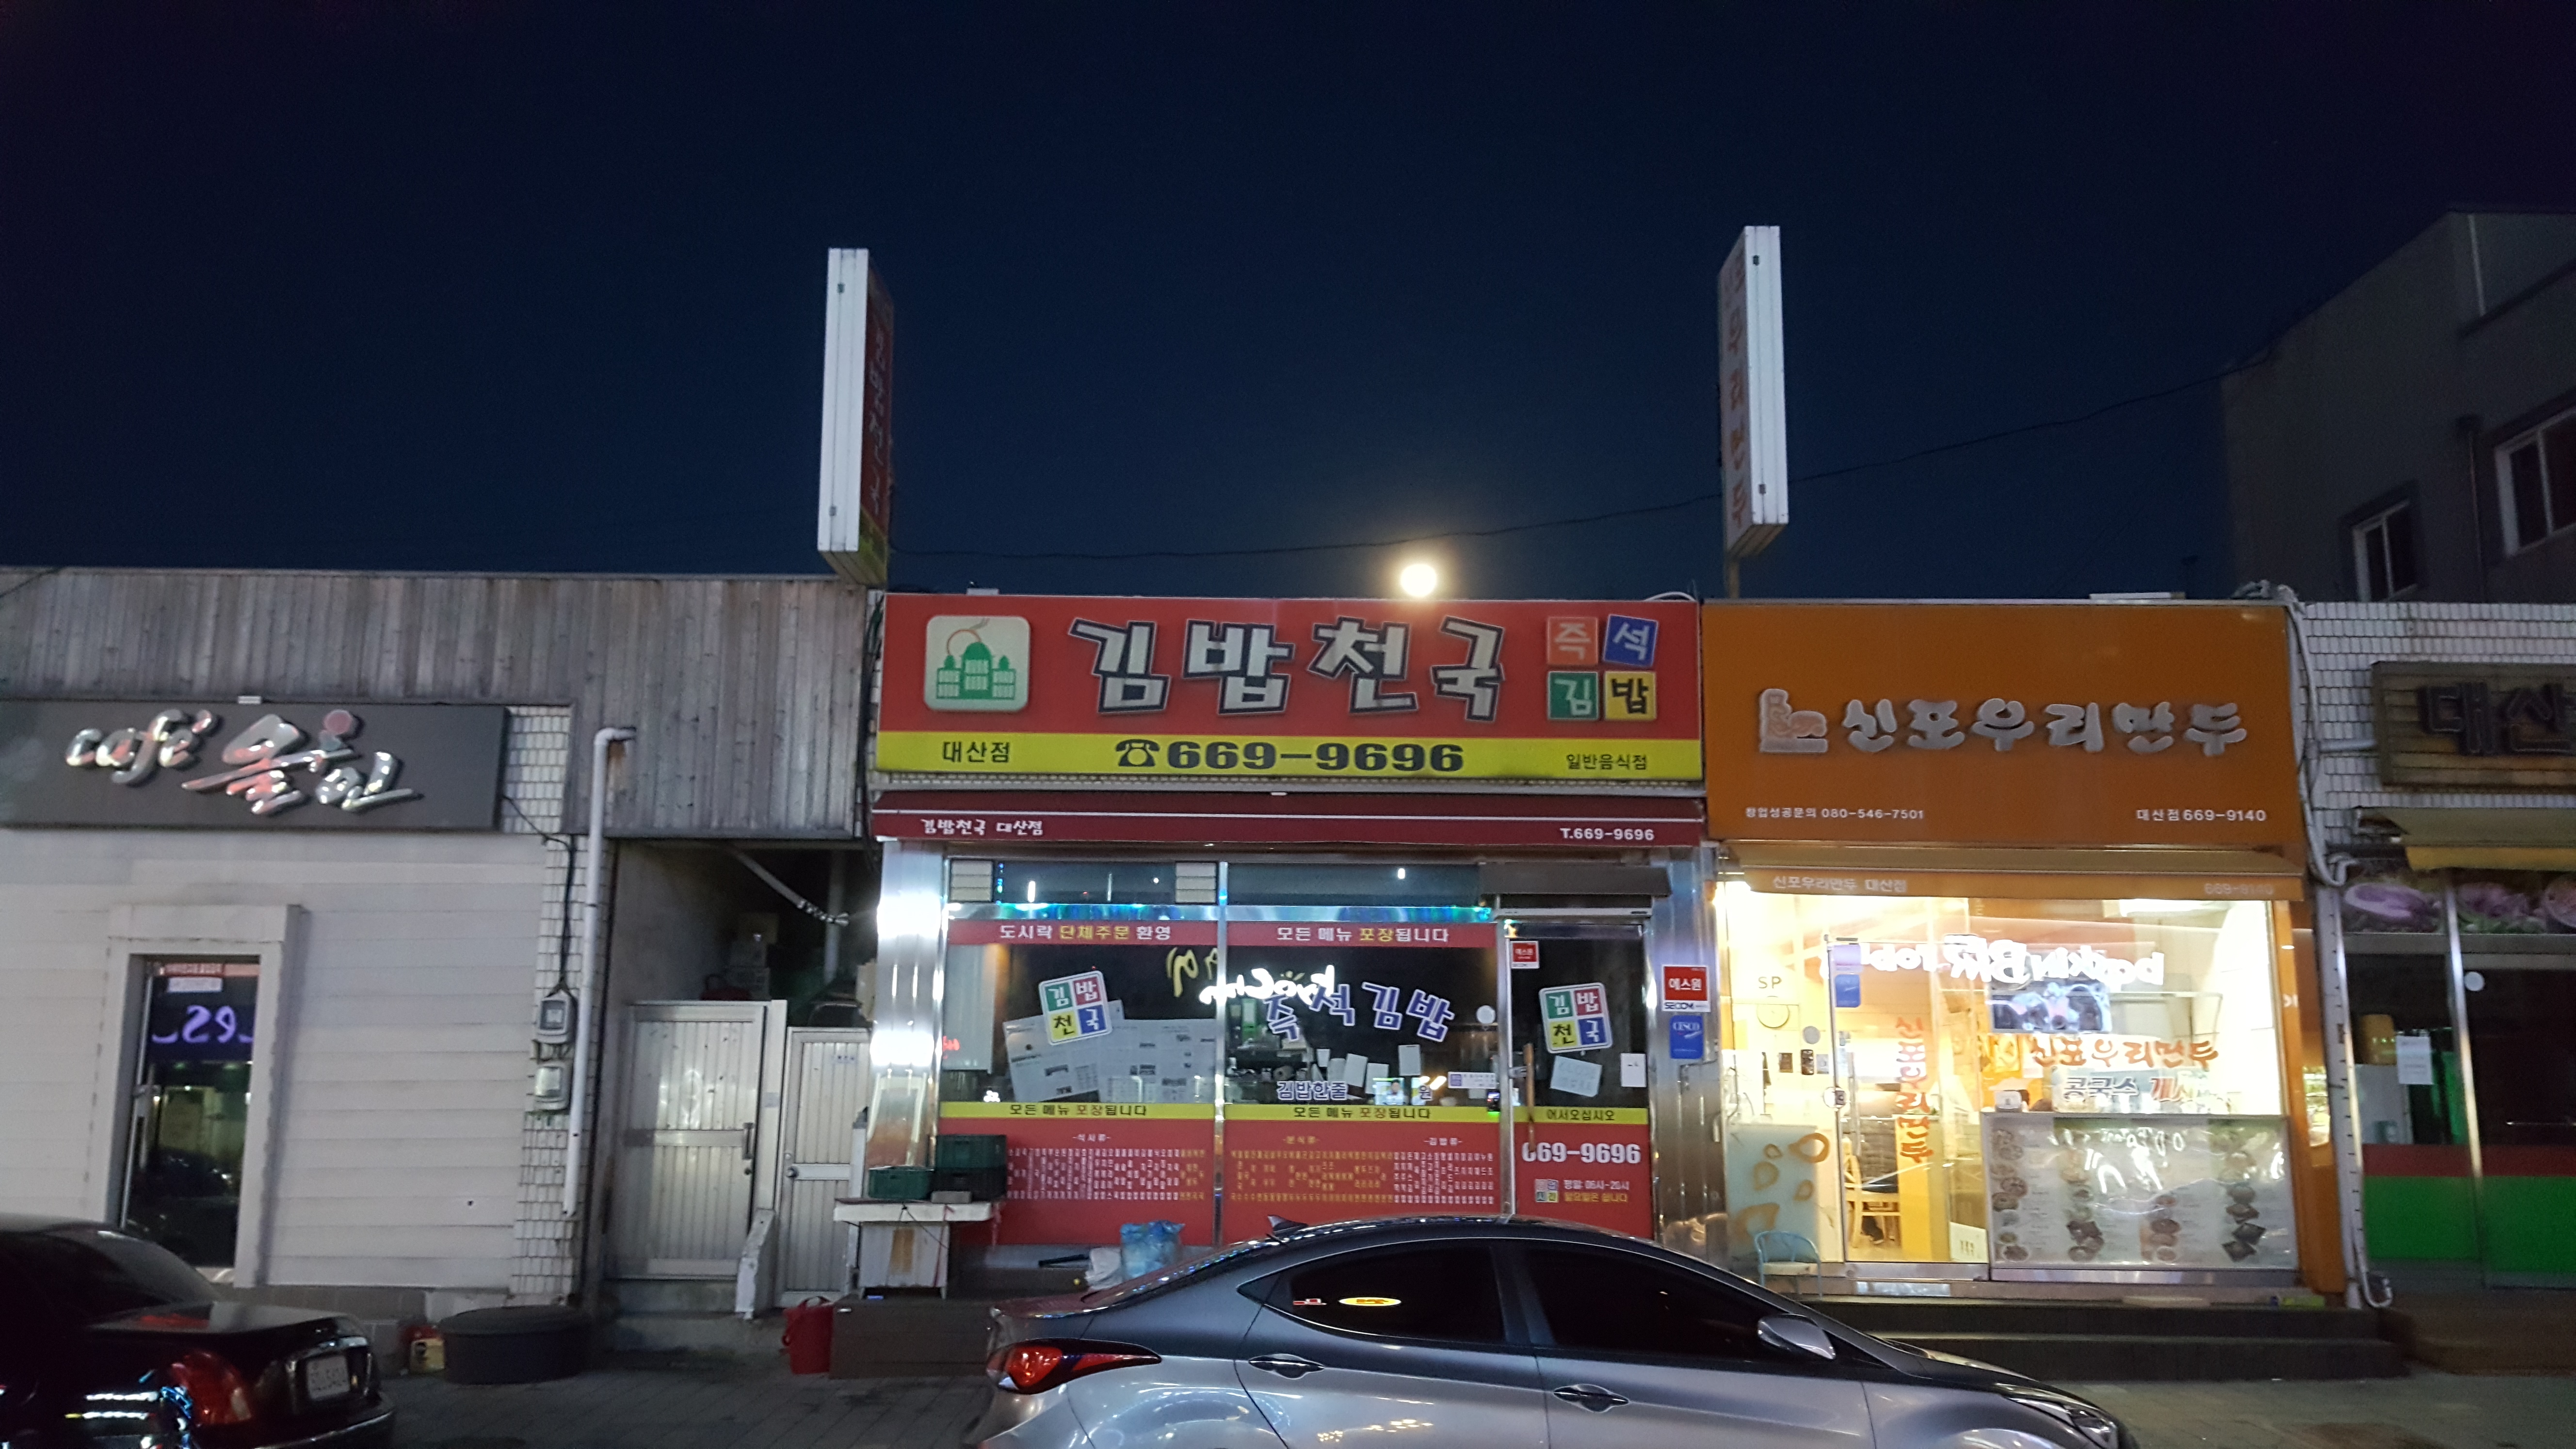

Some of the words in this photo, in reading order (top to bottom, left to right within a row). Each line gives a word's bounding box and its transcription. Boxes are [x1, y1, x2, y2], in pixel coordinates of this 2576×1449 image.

[1555, 622, 1650, 661] 즉석
[1069, 615, 1505, 722] 김밥천국
[1555, 678, 1650, 716] 김밥
[1843, 697, 2247, 757] 신포우리만두
[942, 741, 1011, 763] 대산점
[1168, 741, 1464, 772] 669-9696
[1566, 753, 1647, 770] 일반음식점
[1821, 808, 1925, 820] 080-546-7501
[2137, 808, 2179, 822] 대산점
[2183, 808, 2267, 822] 669-9140
[921, 819, 985, 836] 김밥천국
[997, 820, 1043, 836] 대산점
[1560, 827, 1655, 840] T.669-9696
[1773, 875, 1857, 890] 신포우리만두
[1000, 925, 1053, 939] 도시락
[1060, 925, 1129, 940] 단체주문
[1137, 925, 1171, 940] 환영
[1277, 927, 1311, 941] 모든
[1318, 927, 1352, 942] 메뉴
[1359, 927, 1449, 943] 포장됩니다
[1048, 981, 1098, 1007] 김밥
[1668, 977, 1703, 991] 에스원
[1549, 991, 1600, 1015] 김밥
[1053, 1008, 1100, 1035] 천국
[1553, 1019, 1601, 1045] 천국
[2031, 1037, 2219, 1072] 신포우리만두
[1276, 1080, 1348, 1101] 김밥한줄
[1010, 1104, 1038, 1115] 모든
[1043, 1104, 1070, 1116] 메뉴
[1076, 1104, 1147, 1116] 포장됩니다
[1294, 1107, 1320, 1118] 모든
[1359, 1107, 1431, 1119] 포장됩니다
[1546, 1109, 1615, 1121] 어서오십시오
[1522, 1141, 1641, 1164] 669-9696
